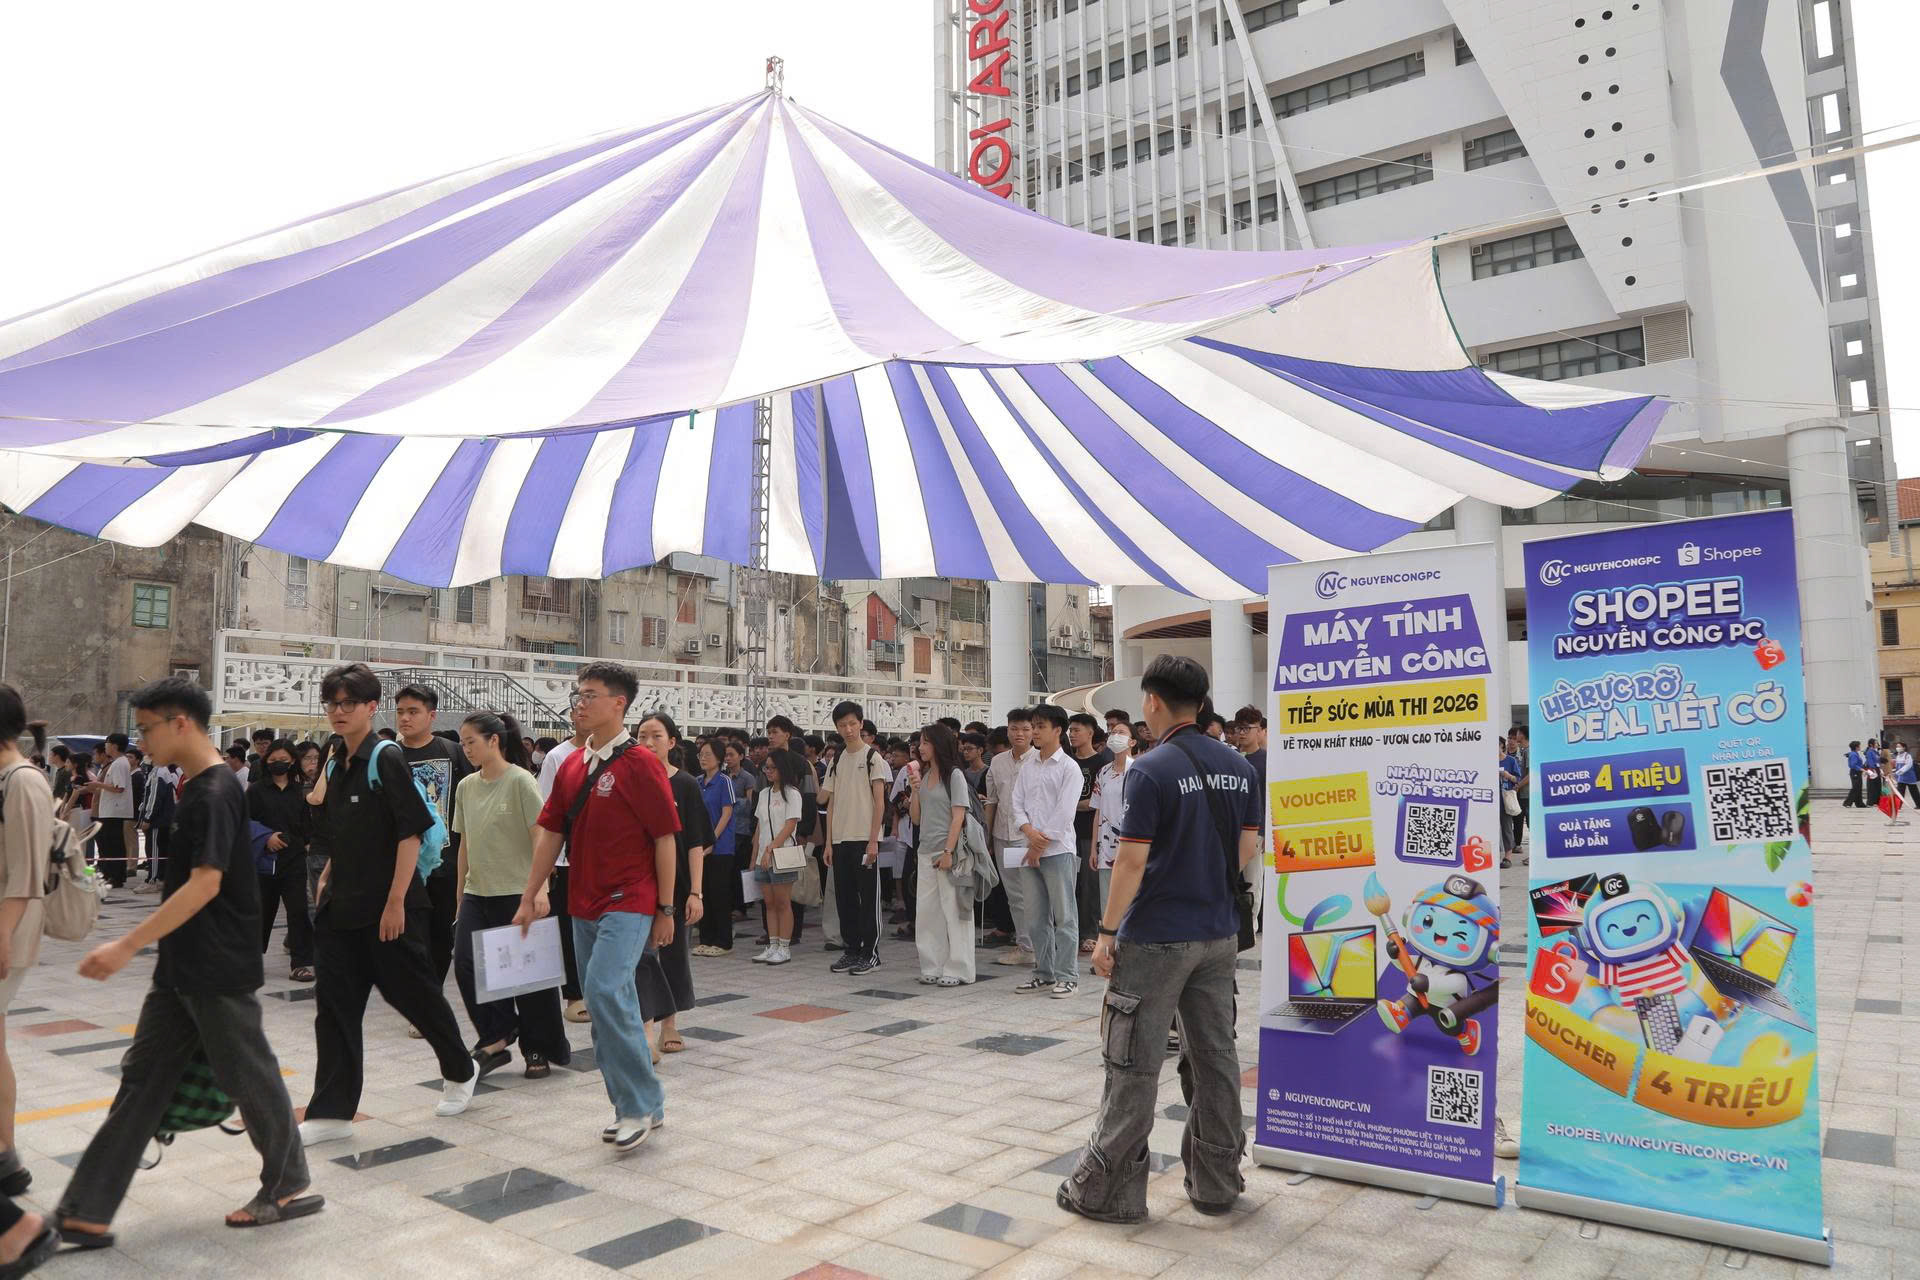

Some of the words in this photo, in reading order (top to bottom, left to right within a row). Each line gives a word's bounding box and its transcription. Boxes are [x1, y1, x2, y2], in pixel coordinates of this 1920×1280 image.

[969, 117, 1012, 198] OI
[1574, 556, 1661, 573] NGUYENCONGPC
[1703, 545, 1762, 563] Shopee
[1350, 571, 1441, 586] NGUYENCONGPC
[1574, 580, 1740, 627] SHOPEE
[1304, 611, 1372, 647] MÁY
[1383, 602, 1462, 637] TÍNH
[1557, 625, 1647, 654] NGUYỄN
[1653, 624, 1723, 646] CÔNG
[1730, 622, 1764, 641] PC
[1279, 643, 1391, 685] NGUYỄN
[1401, 643, 1486, 674] CÔNG
[1543, 684, 1577, 719] HÈ
[1578, 677, 1632, 709] RỰC
[1634, 668, 1679, 697] RỠ
[1288, 695, 1323, 725] TIẾP
[1328, 699, 1359, 722] SỨC
[1364, 696, 1395, 720] MÙA
[1399, 697, 1427, 716] THI
[1433, 693, 1479, 714] 2026
[1567, 706, 1648, 744] DEAL
[1652, 683, 1720, 733] HẾT
[1728, 681, 1785, 725] CỠ
[1298, 739, 1321, 751] TRỌN
[1324, 734, 1345, 748] KHÁT
[1349, 735, 1373, 747] KHAO
[1412, 733, 1431, 744] CAO
[1456, 727, 1482, 742] SÁNG
[1178, 775, 1203, 795] HAU
[1387, 763, 1431, 783] NHẬN
[1434, 769, 1478, 783] NGAY
[1547, 771, 1591, 783] VOUCHER
[1595, 764, 1613, 791] 4
[1620, 761, 1682, 791] TRIỆU
[1280, 788, 1357, 809] VOUCHER
[1376, 781, 1398, 796] ƯU
[1432, 786, 1493, 804] SHOPEE
[1550, 783, 1591, 796] LAPTOP
[1558, 819, 1582, 832] QUÀ
[1583, 817, 1611, 832] TẶNG
[1282, 840, 1296, 858] 4
[1300, 830, 1363, 860] TRIỆU
[1565, 833, 1585, 848] HẤP
[1532, 891, 1541, 899] LG
[1526, 1000, 1617, 1071] VOUCHER
[1285, 1092, 1371, 1114] NGUYENCONGPC.VN
[1651, 1070, 1673, 1097] 4
[1684, 1076, 1794, 1118] TRIỆU
[1546, 1123, 1788, 1171] SHOPEE.VN/NGUYENCONGPC.VN
